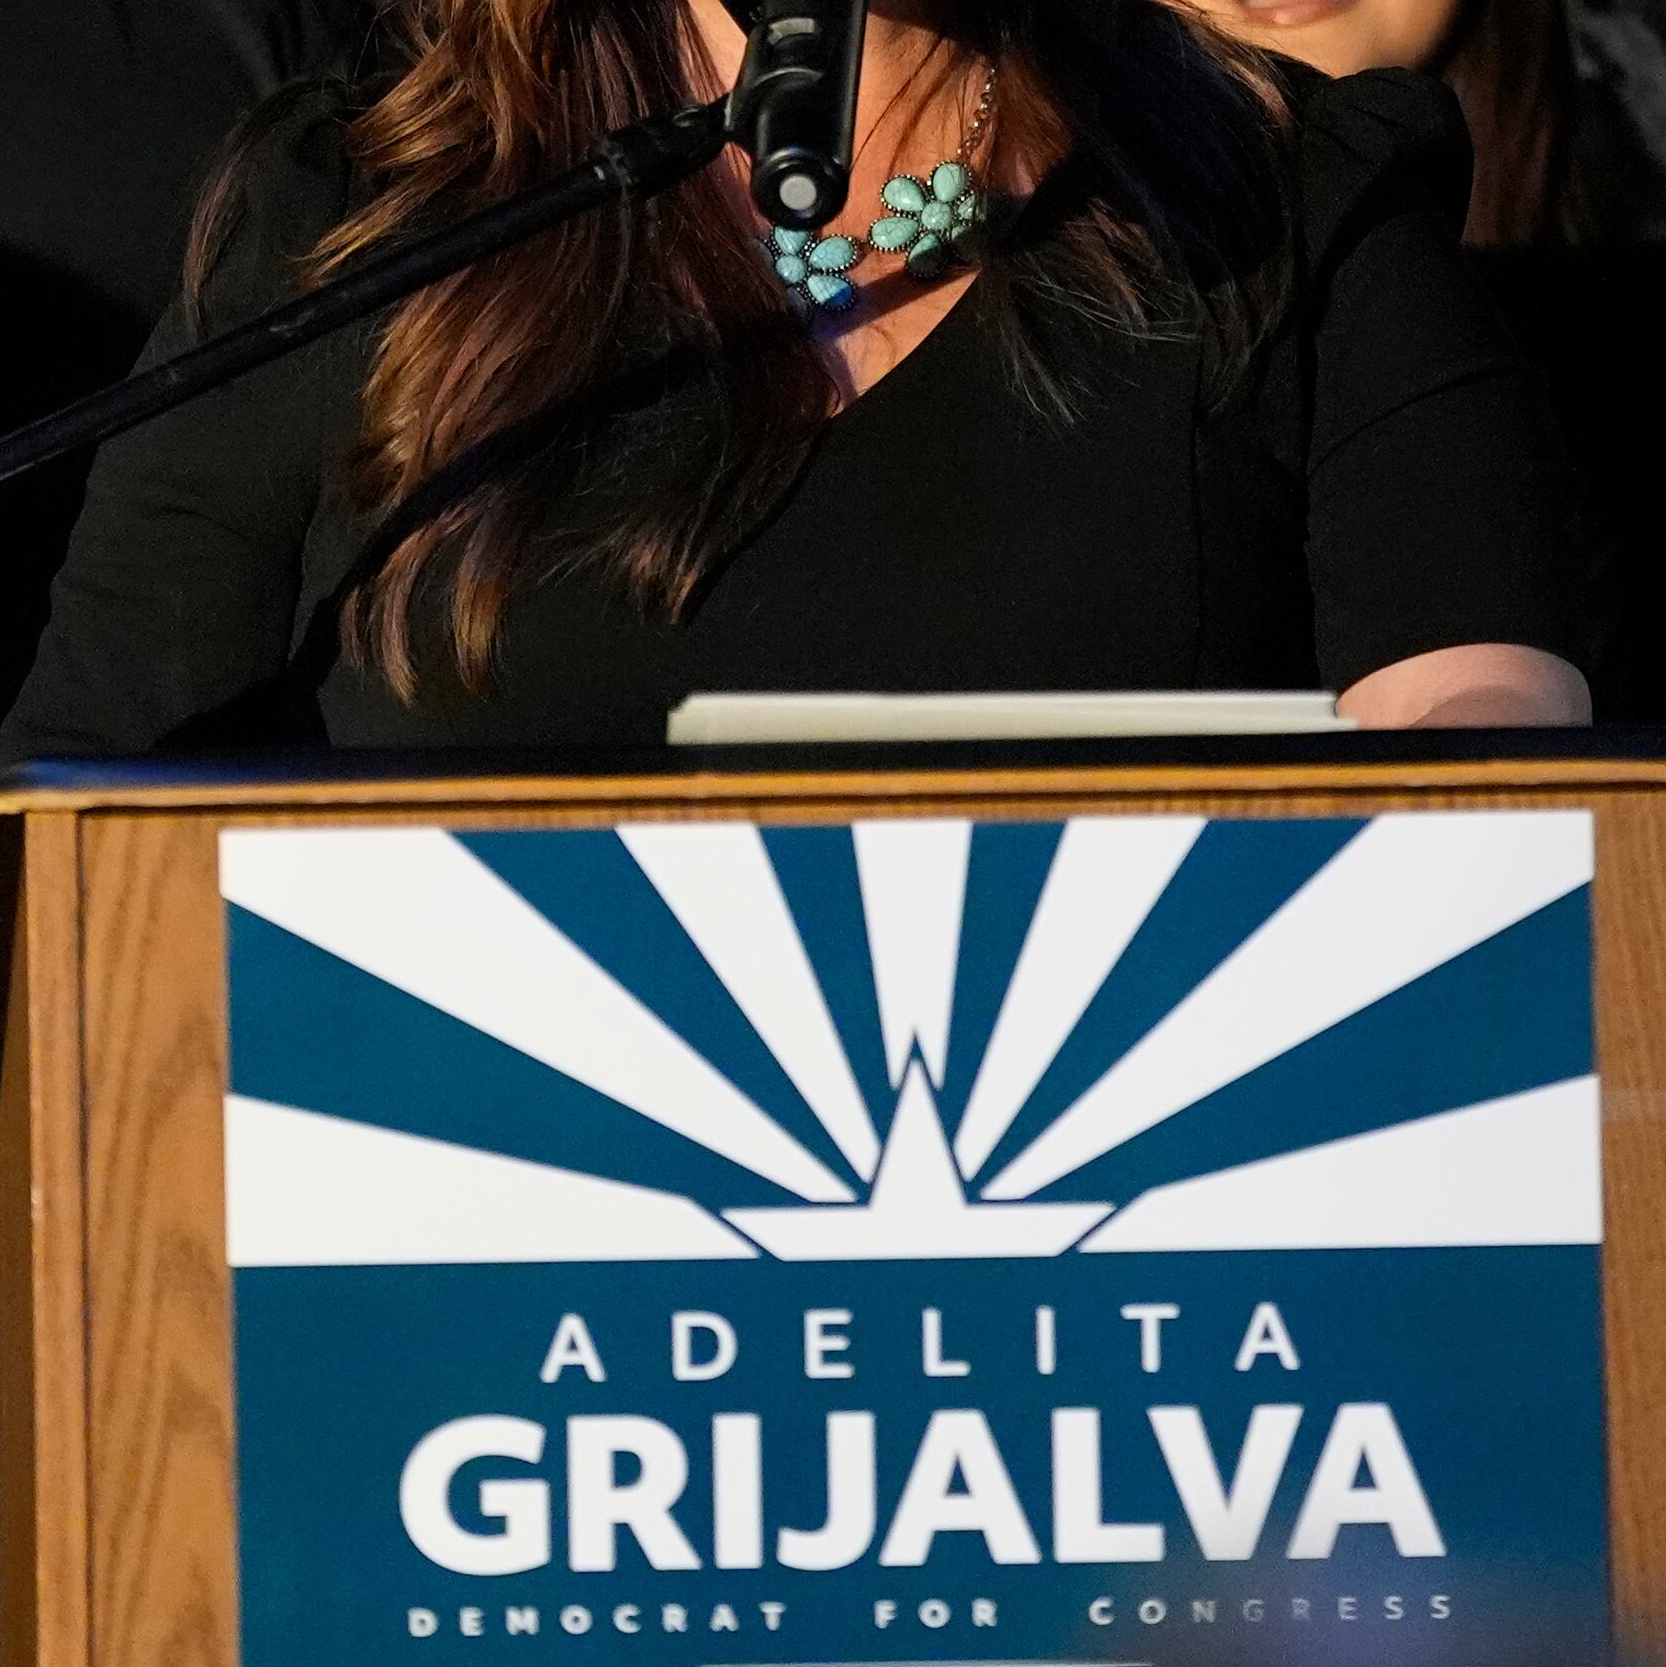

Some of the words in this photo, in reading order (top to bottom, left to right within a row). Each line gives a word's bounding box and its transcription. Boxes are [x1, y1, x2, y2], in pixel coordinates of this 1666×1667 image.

[540, 1302, 1300, 1383] ADELITA
[398, 1401, 1448, 1576] GRIJALVA
[407, 1600, 787, 1638] DEMOCRAT
[874, 1597, 998, 1631] FOR
[1087, 1594, 1453, 1627] CONGRESS
